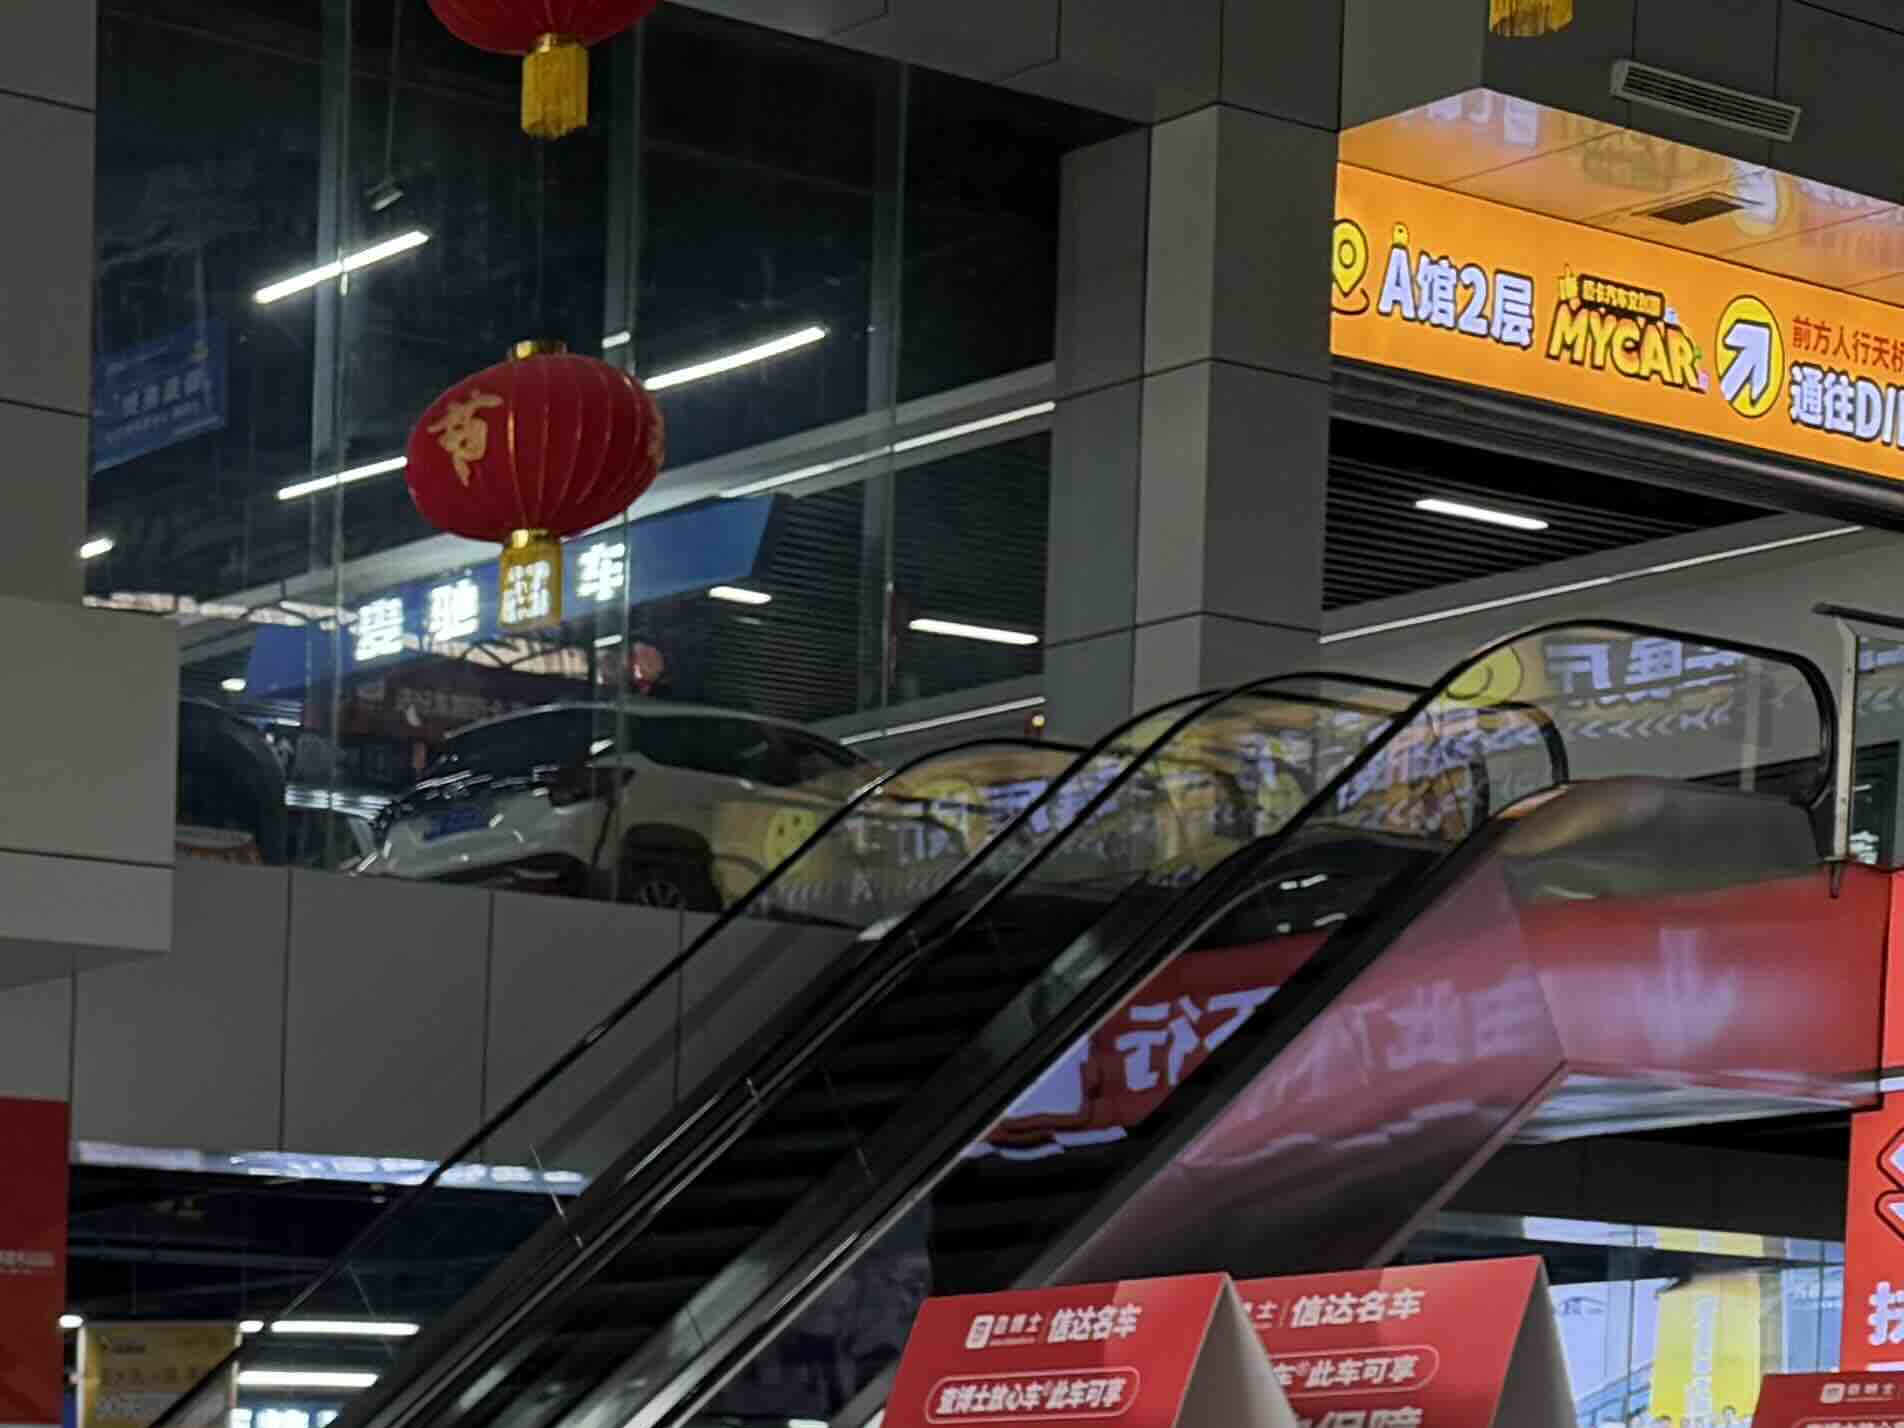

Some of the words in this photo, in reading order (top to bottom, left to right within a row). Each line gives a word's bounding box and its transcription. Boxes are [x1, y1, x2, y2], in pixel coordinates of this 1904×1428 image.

[1379, 245, 1534, 347] A馆2层
[1545, 303, 1704, 392] MYCAR
[1791, 363, 1904, 446] 通往D/
[1047, 1304, 1142, 1344] 信达名车
[1291, 1288, 1425, 1328] 信达名车
